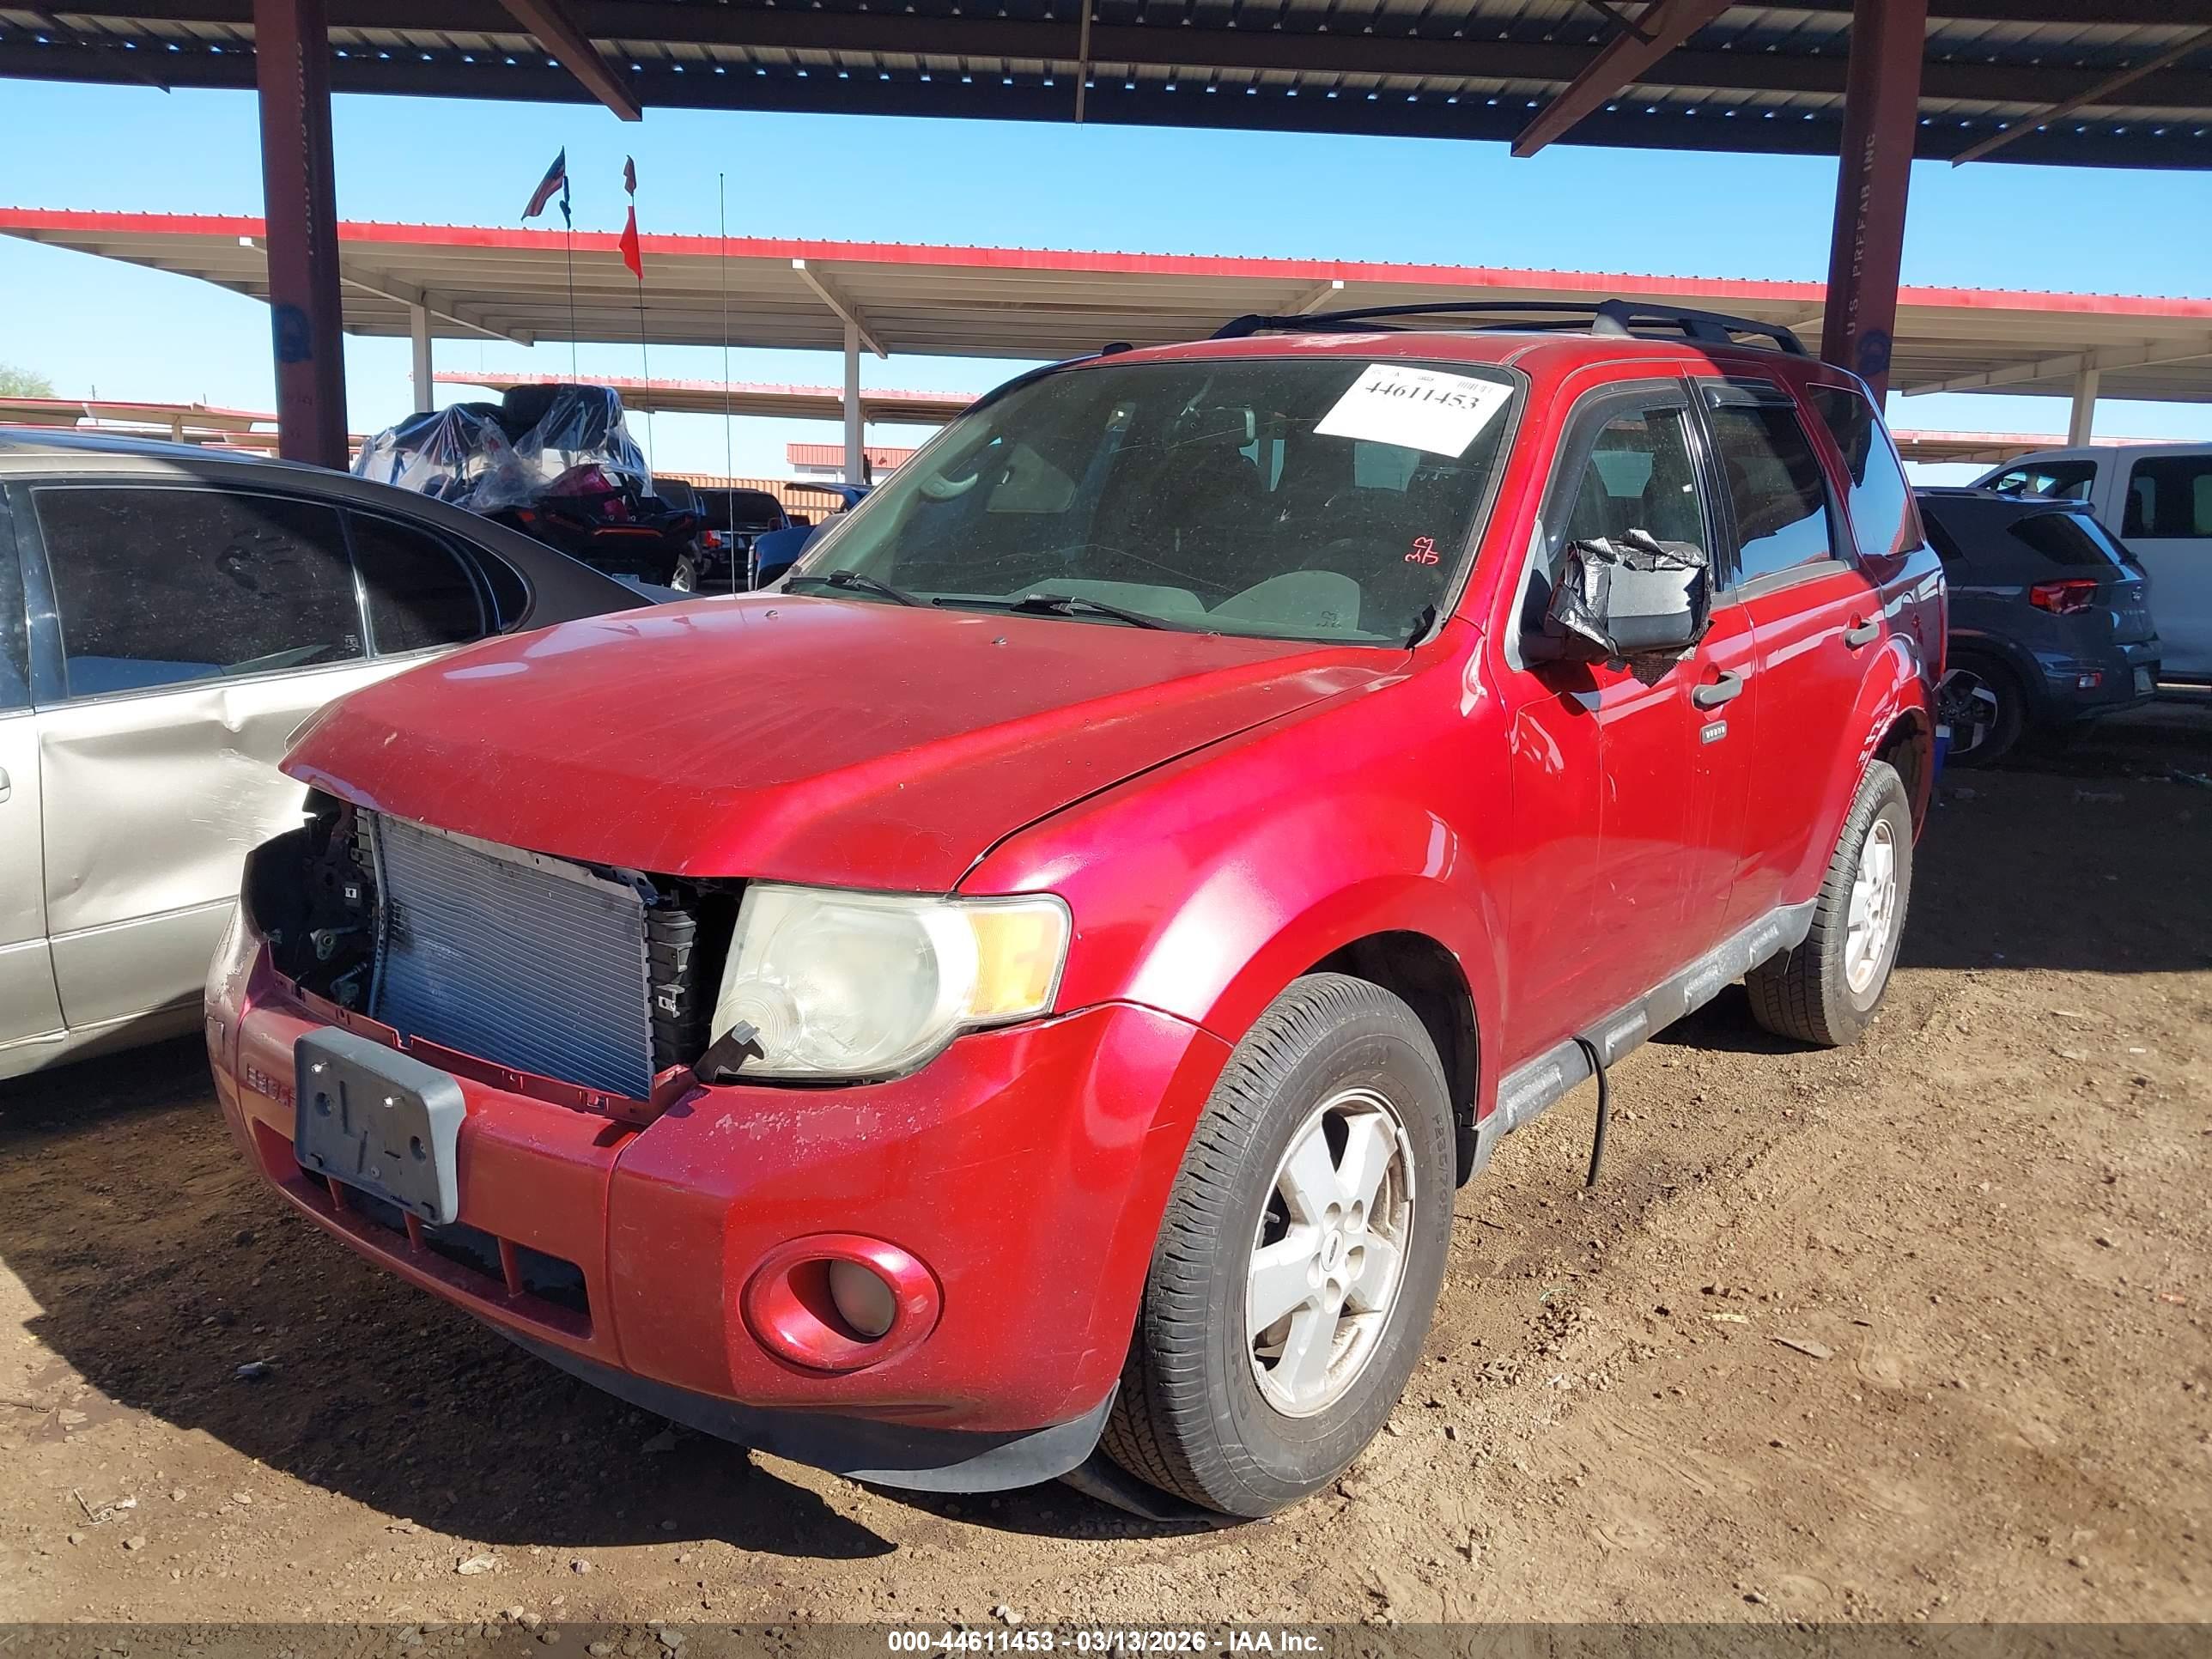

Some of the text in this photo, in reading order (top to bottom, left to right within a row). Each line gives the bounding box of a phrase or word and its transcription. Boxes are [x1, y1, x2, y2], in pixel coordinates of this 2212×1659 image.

[1852, 184, 1871, 277] PREFAB
[1863, 132, 1876, 172] INC
[1365, 380, 1480, 410] 44611453
